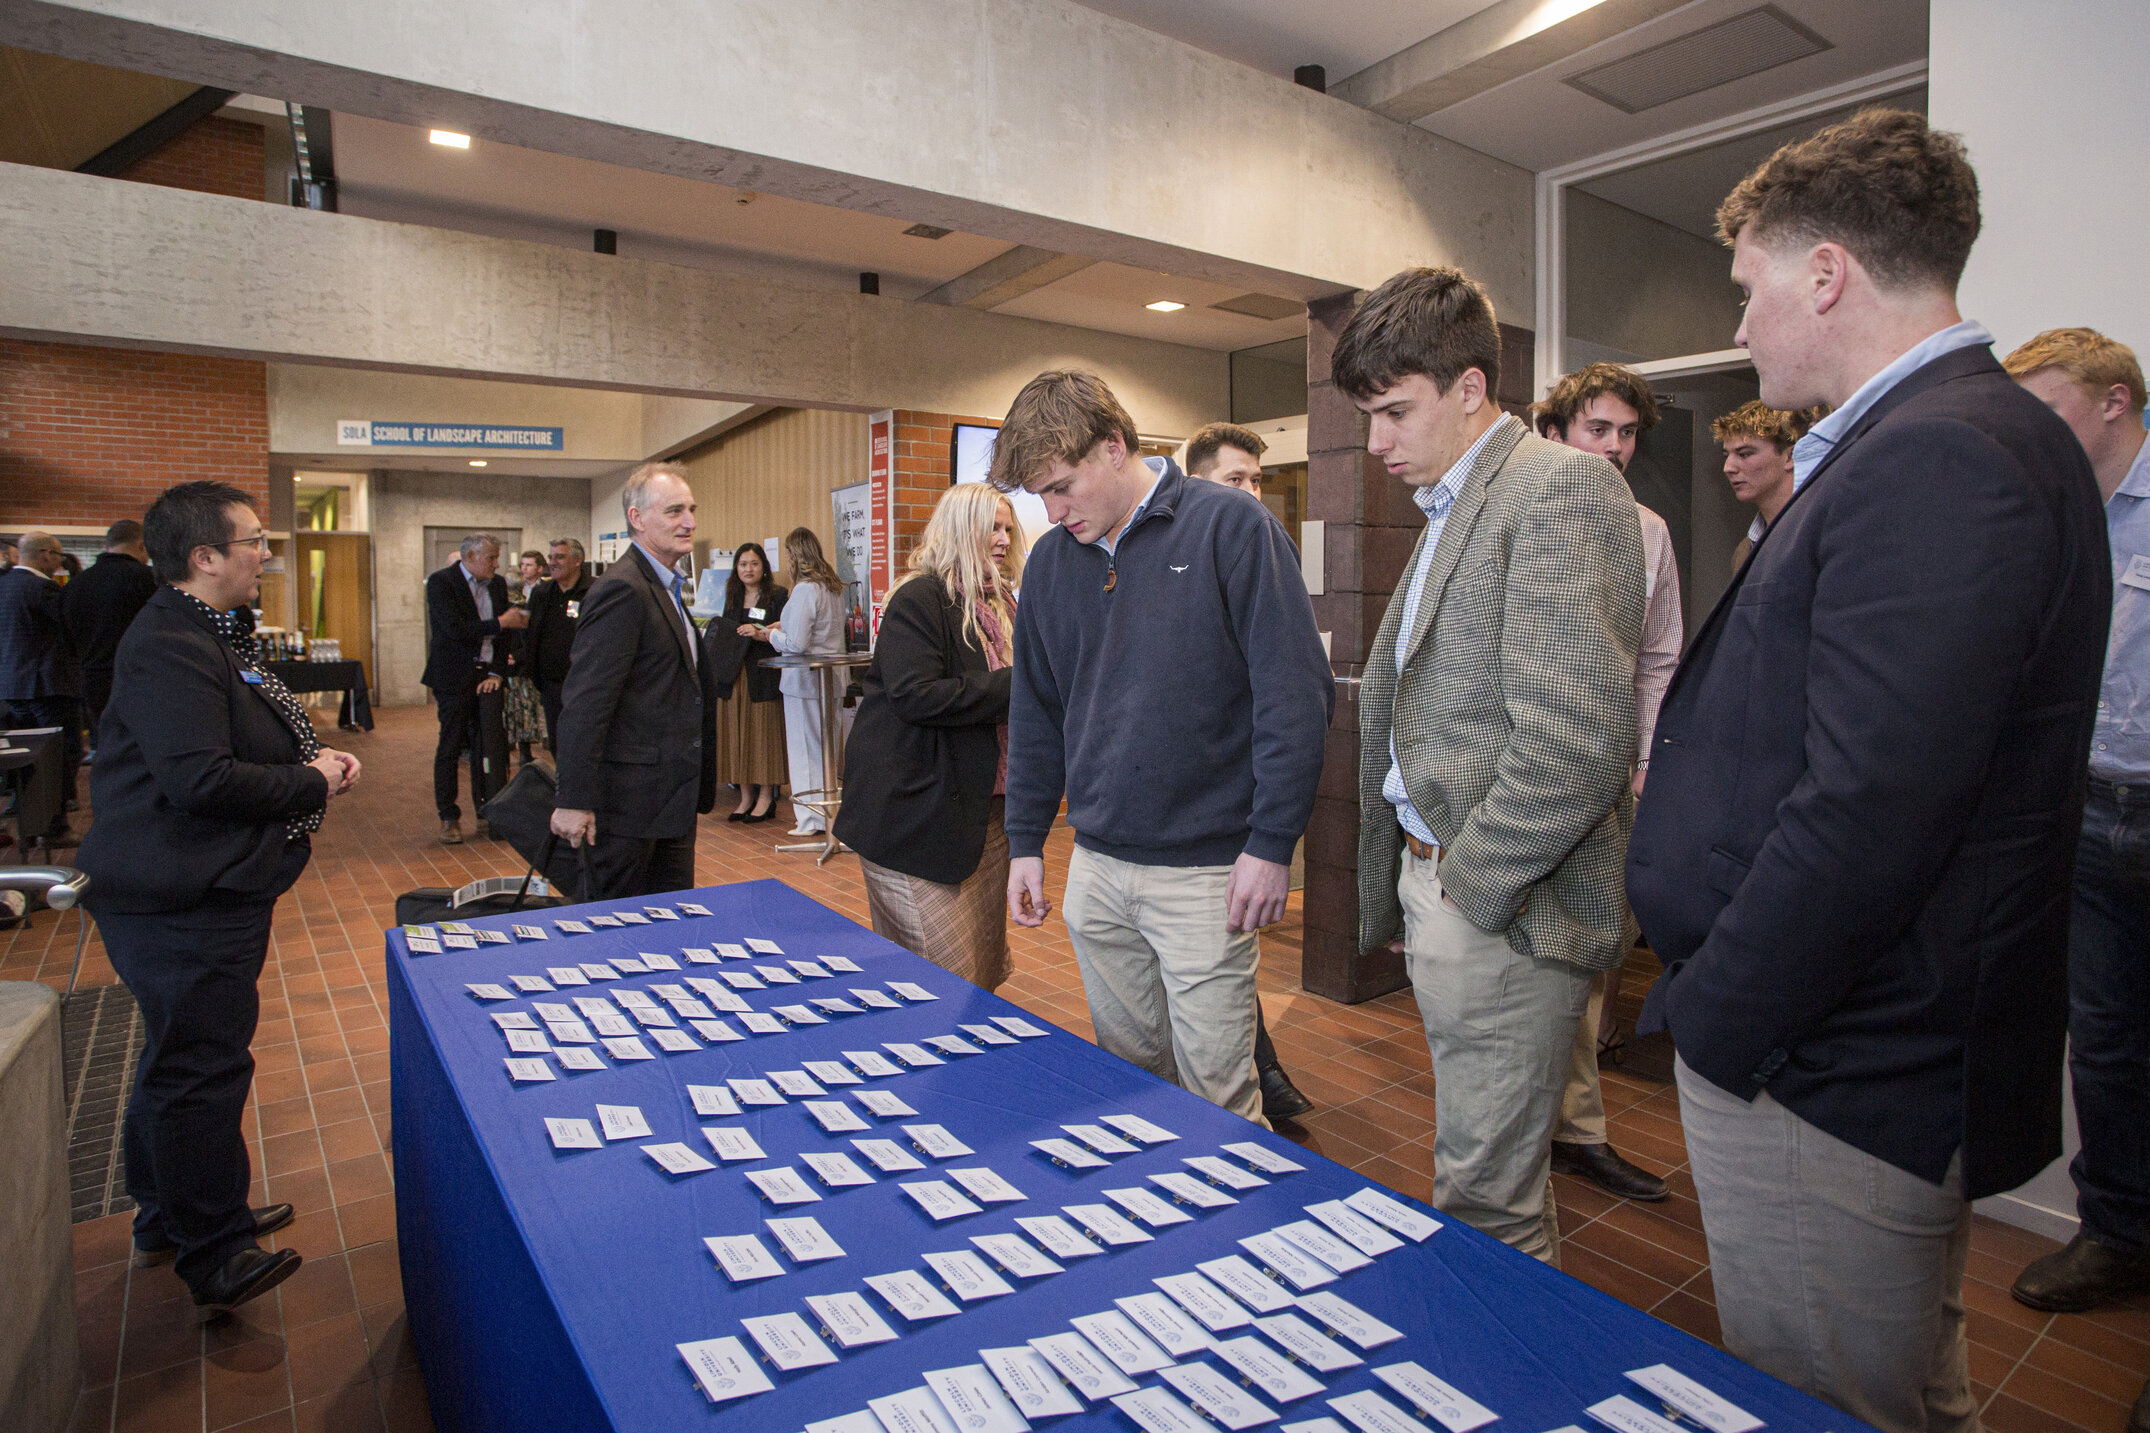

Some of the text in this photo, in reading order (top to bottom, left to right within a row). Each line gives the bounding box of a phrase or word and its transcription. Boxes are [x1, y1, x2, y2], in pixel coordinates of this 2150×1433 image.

[343, 426, 552, 445] SOLA SCHOOL OF LANDSCAPE ARCHITECTURE
[842, 511, 850, 521] WE
[853, 527, 865, 537] WHAT
[846, 546, 863, 556] WE DO
[1001, 1357, 1030, 1390] UNIVERSITY
[1003, 1367, 1024, 1391] LINCOLN
[943, 1376, 972, 1412] UNIVERSITY
[945, 1388, 966, 1412] LINCOLN
[891, 1403, 916, 1433] NIVERSITY
